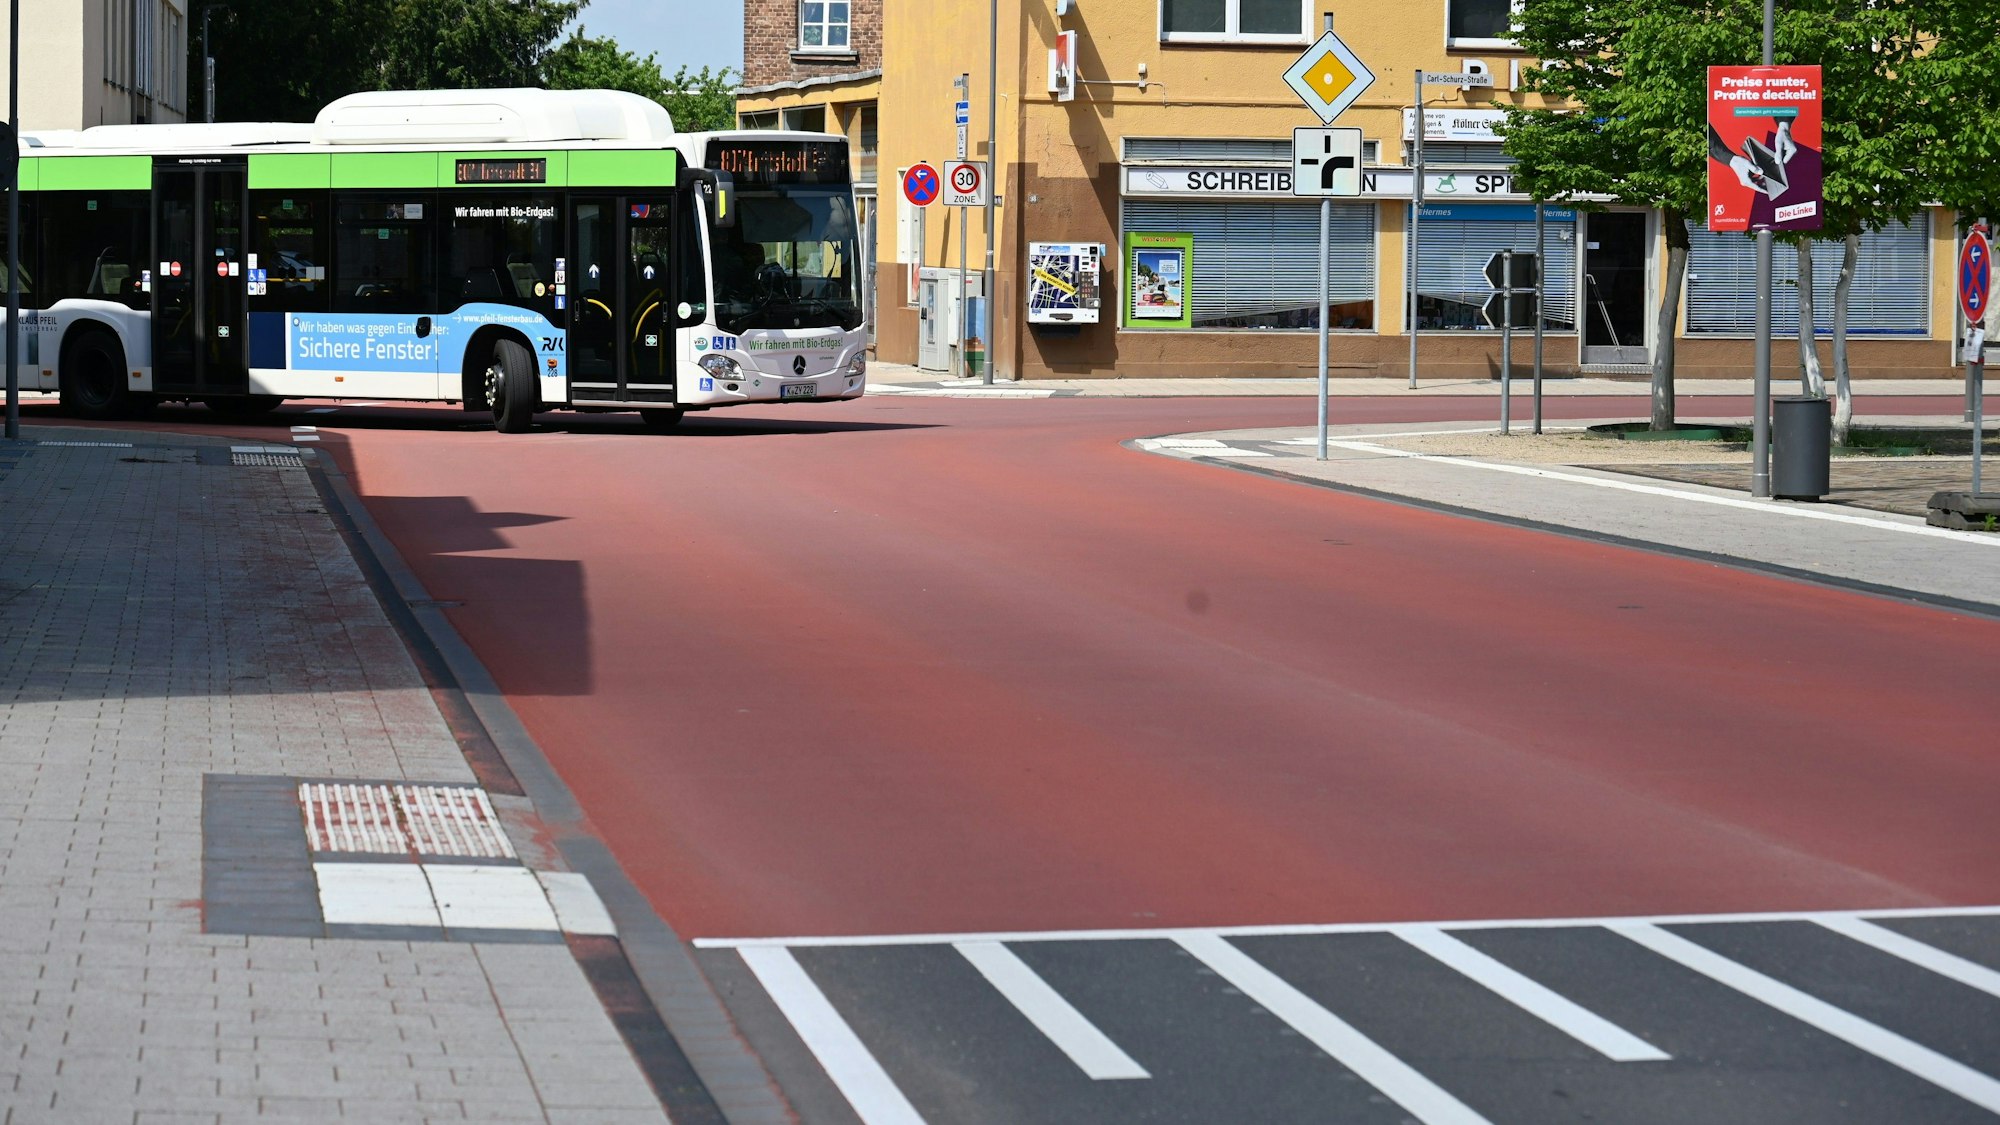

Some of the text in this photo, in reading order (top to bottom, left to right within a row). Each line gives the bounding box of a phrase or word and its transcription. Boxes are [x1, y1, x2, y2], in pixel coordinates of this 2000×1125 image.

[1427, 74, 1488, 84] Carl-Schurz-Straße
[1721, 76, 1809, 88] Preise runter,
[1713, 89, 1817, 100] Profite deckeln!
[1452, 118, 1481, 129] Kölner
[956, 172, 974, 186] 30
[1187, 171, 1377, 192] SCHREIBN
[953, 195, 976, 203] ZONE
[455, 206, 554, 219] Wir fahren mit Bio-Erdgas!
[1422, 207, 1452, 217] Hermes
[1543, 209, 1572, 217] Hermes
[1778, 206, 1814, 219] Die Linke
[18, 316, 57, 325] KLAUS PFEIL
[463, 313, 543, 323] www.pfeil-fensterbau.de
[299, 321, 314, 333] Wir
[317, 321, 345, 333] haben
[347, 324, 366, 333] was
[367, 324, 395, 337] gegen
[299, 336, 361, 359] Sichere
[749, 336, 844, 350] Wir fahren mit Bio-Erdgas!
[547, 367, 558, 377] 228
